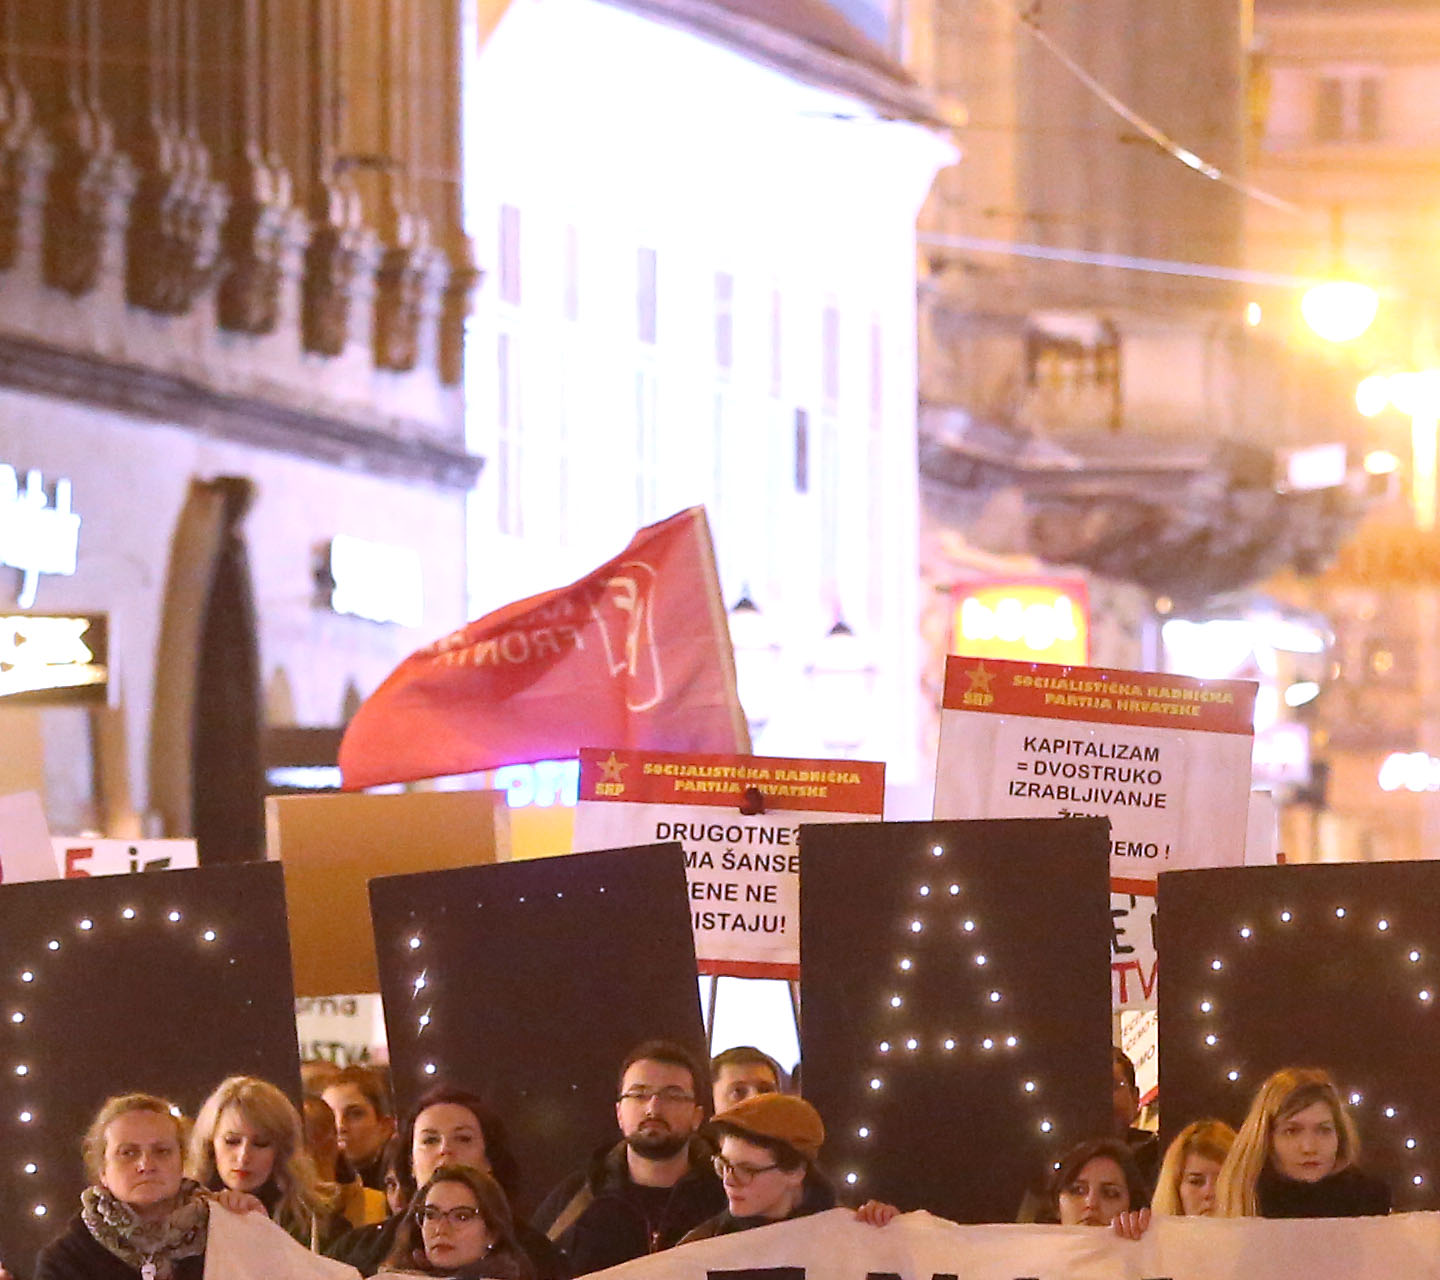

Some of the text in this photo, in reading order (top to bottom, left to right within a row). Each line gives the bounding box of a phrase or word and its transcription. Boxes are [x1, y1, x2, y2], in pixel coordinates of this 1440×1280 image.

[1044, 692, 1202, 718] PARTIJA HRVATSKE
[1023, 736, 1160, 762] KAPITALIZAM
[1033, 759, 1163, 786] DVOSTRUKO
[594, 782, 626, 797] SRP
[673, 779, 740, 794] PARTIJA
[1008, 780, 1168, 809] IZRABLJIVANJE
[721, 848, 800, 875] ŠANSE
[746, 883, 778, 903] NE
